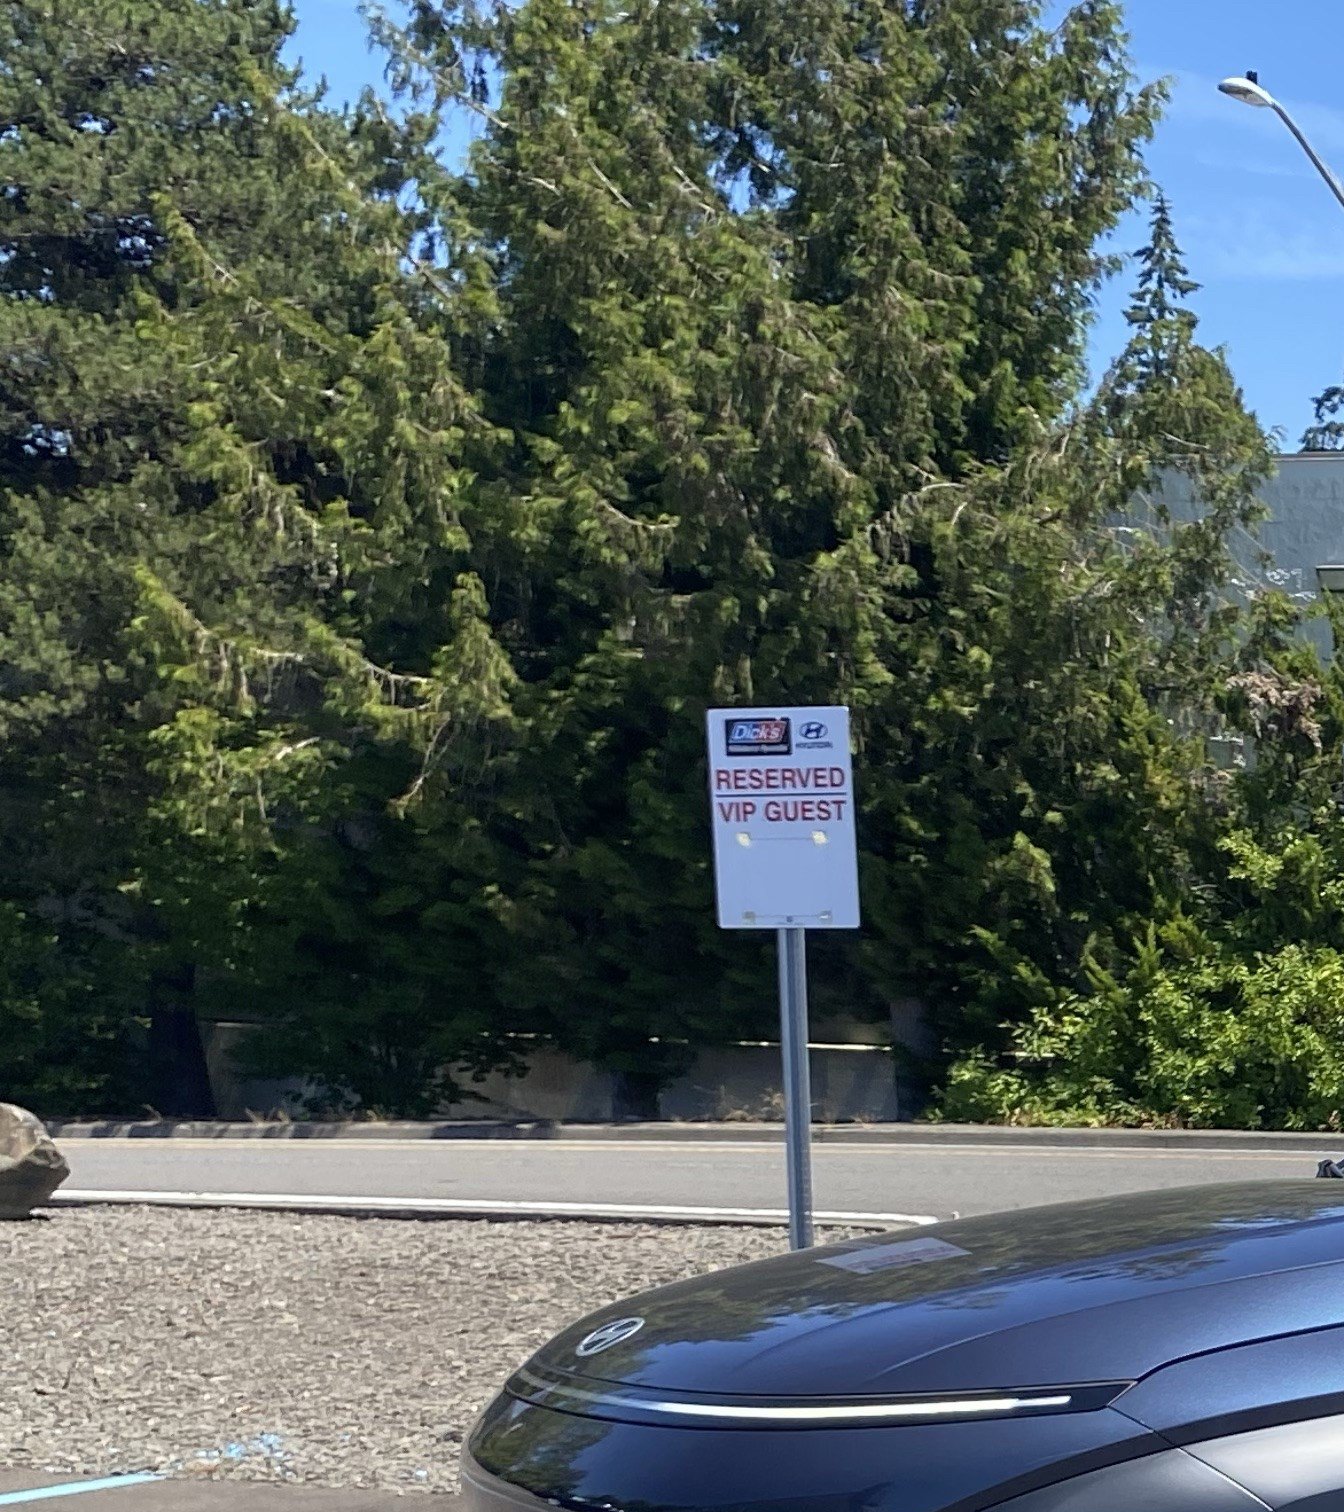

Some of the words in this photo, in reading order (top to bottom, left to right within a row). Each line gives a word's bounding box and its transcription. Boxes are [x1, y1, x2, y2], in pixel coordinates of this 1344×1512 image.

[715, 766, 846, 791] RESERVED
[718, 801, 757, 823] VIP
[764, 799, 847, 822] GUEST
